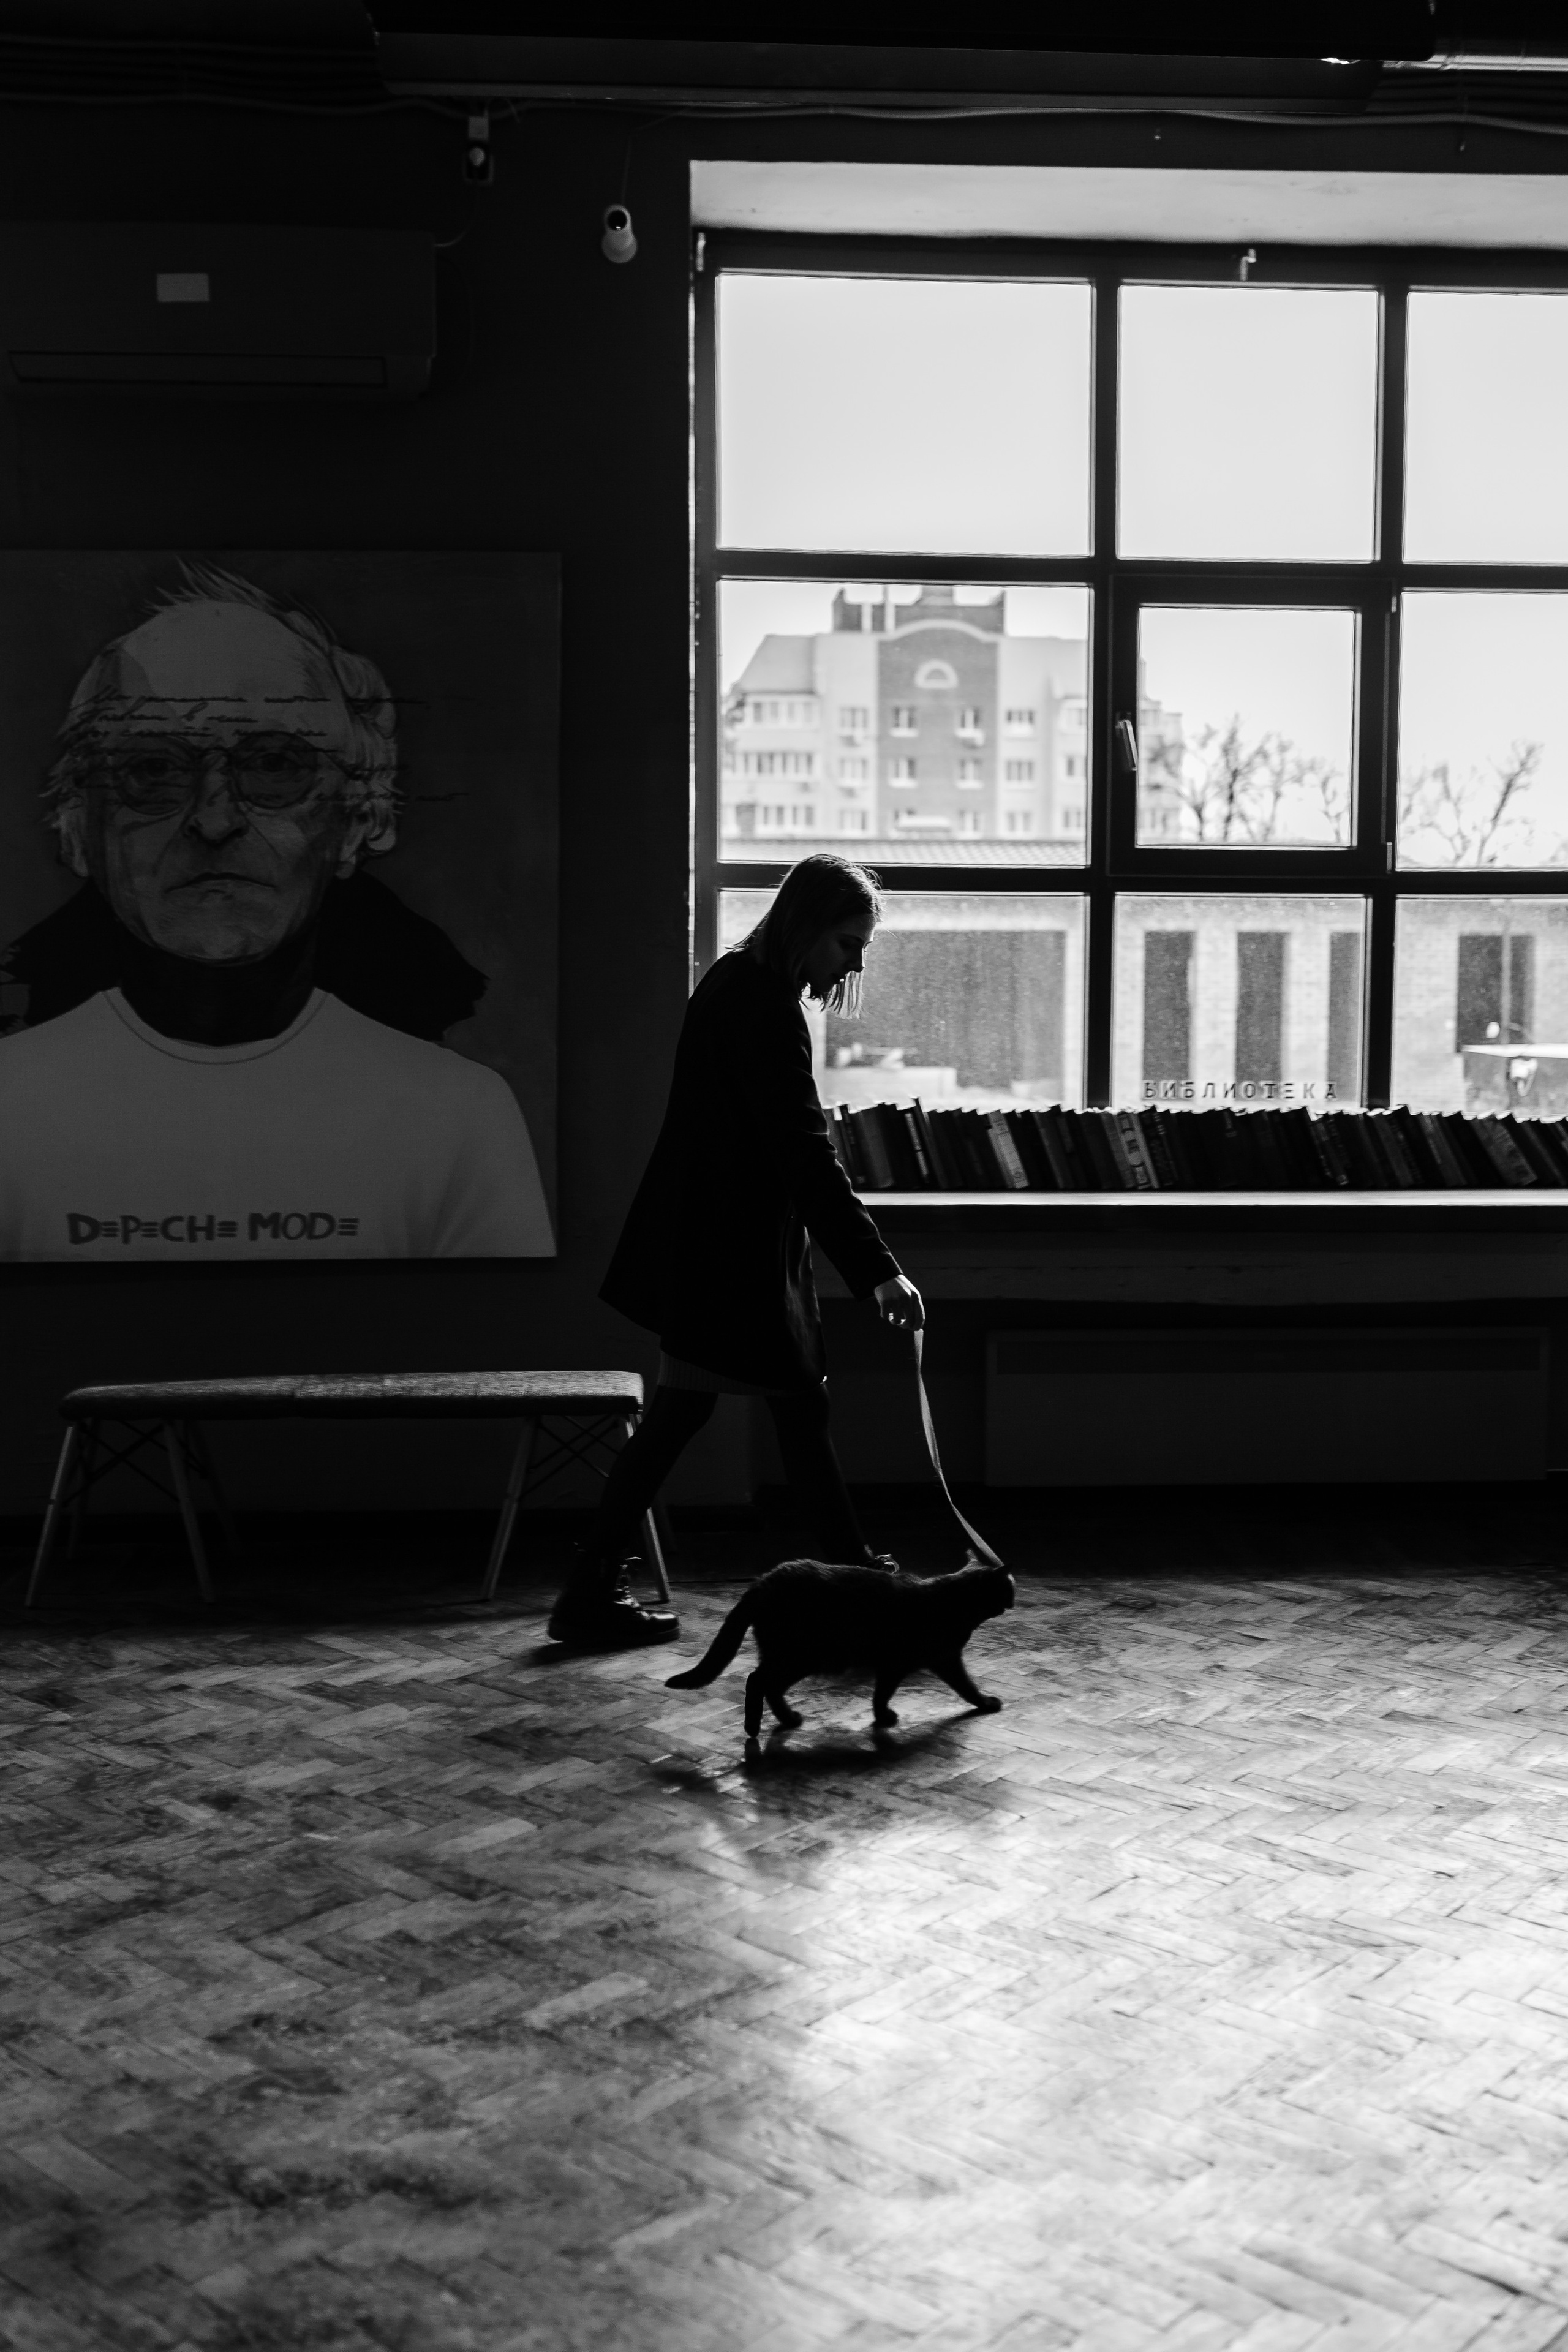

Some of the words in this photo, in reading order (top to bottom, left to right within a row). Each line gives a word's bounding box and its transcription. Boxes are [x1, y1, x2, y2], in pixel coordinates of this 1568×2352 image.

[1144, 1080, 1337, 1099] БИБЛИОТЕКА
[66, 1212, 238, 1245] DEPECHE
[248, 1212, 359, 1242] MODE
